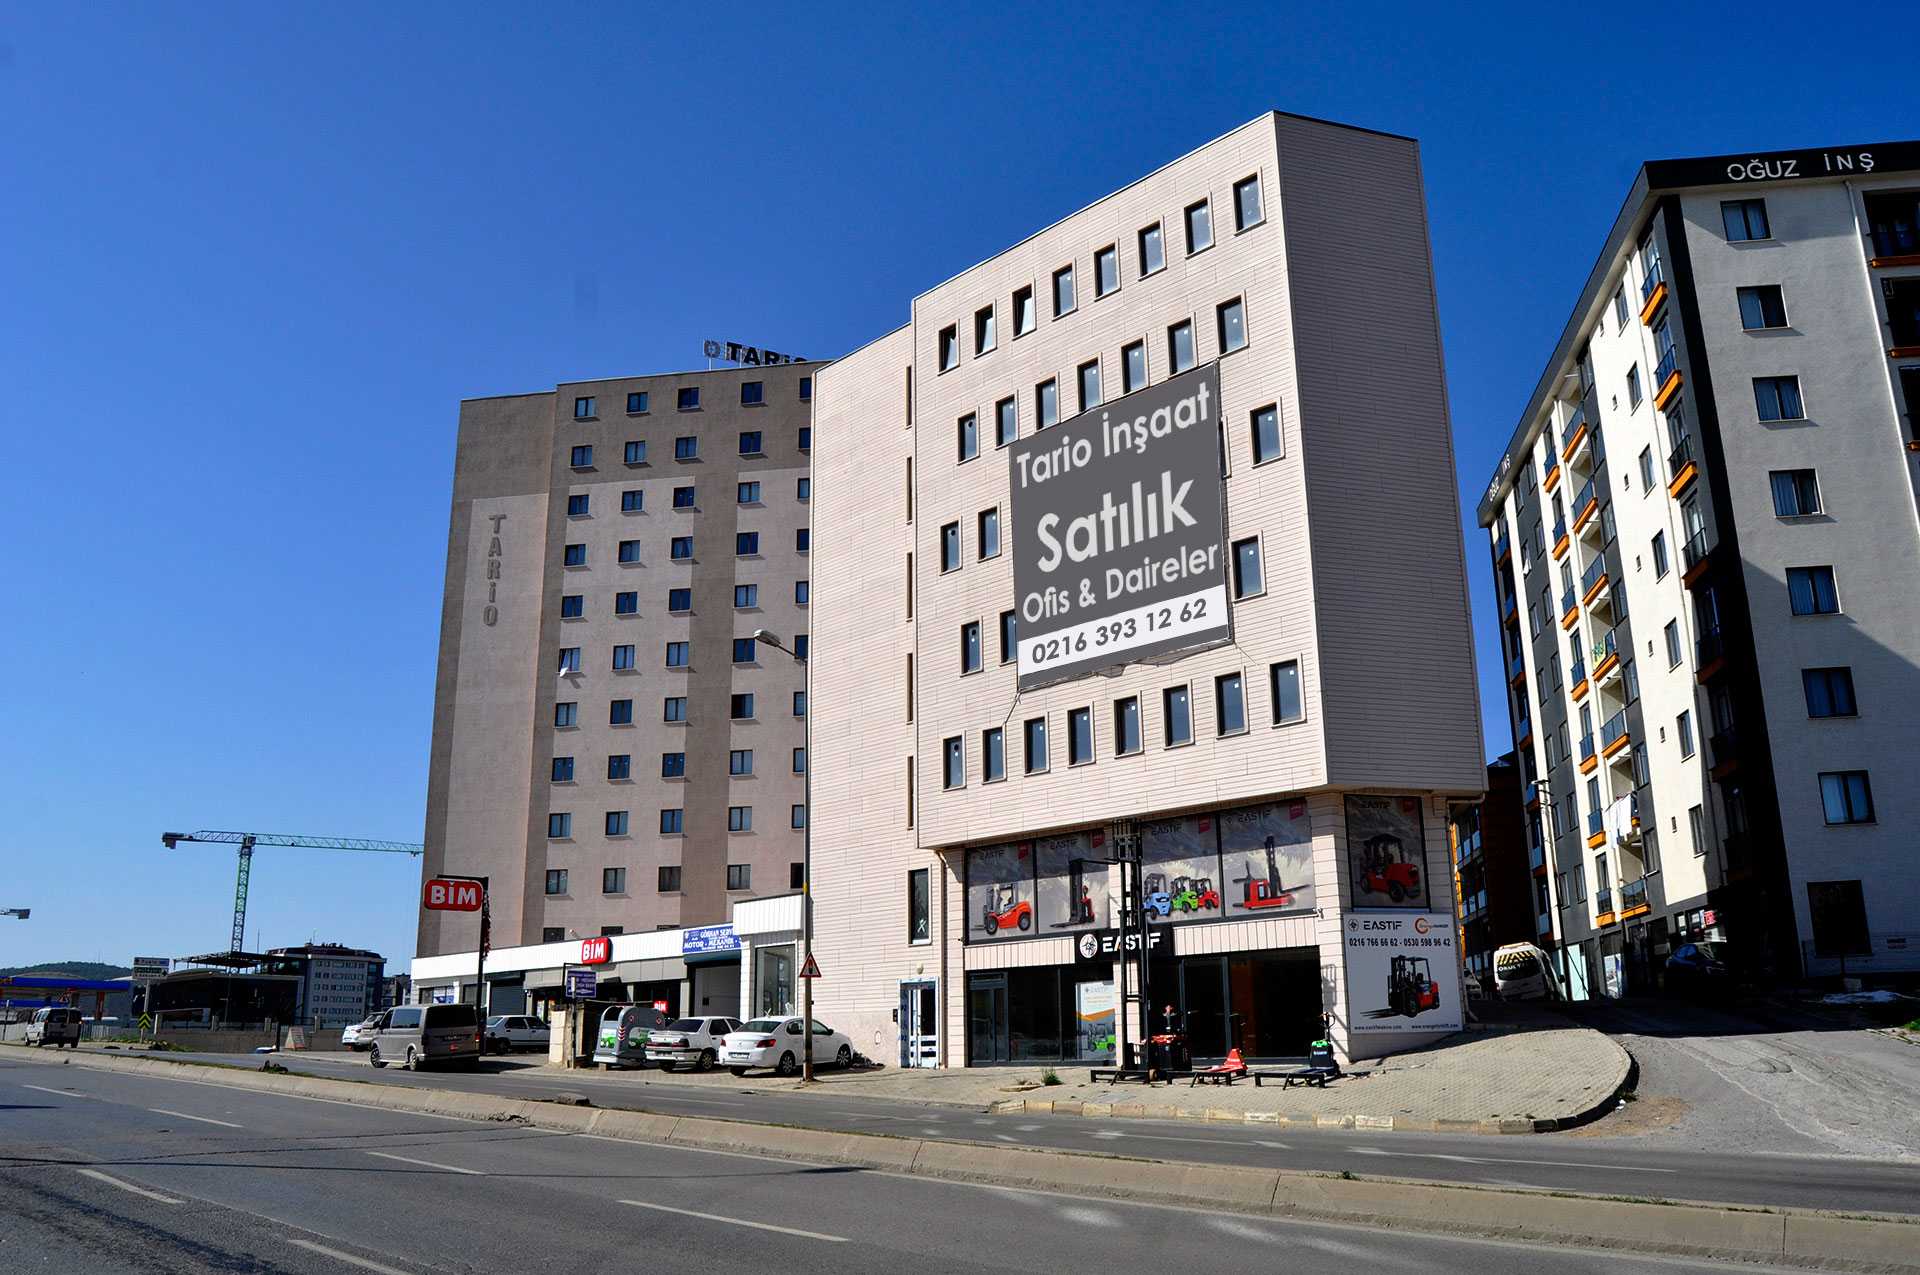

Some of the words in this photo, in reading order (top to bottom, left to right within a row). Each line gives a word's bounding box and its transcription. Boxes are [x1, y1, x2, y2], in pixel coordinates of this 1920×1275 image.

[1727, 159, 1800, 181] OĞUZ
[1824, 153, 1874, 172] İNŞ
[1016, 435, 1092, 489] Tario
[1102, 382, 1210, 457] İnşaat
[1037, 470, 1198, 572] Satılık
[1023, 586, 1071, 623] Ofis
[1079, 578, 1096, 608] &
[1106, 544, 1218, 600] Daireler
[1032, 632, 1087, 664] 0216
[1096, 617, 1137, 646] 393
[1146, 608, 1172, 632] 12
[1180, 598, 1207, 622] 62
[431, 881, 477, 905] BİM
[1363, 920, 1402, 930] EASTIF
[583, 939, 604, 961] BİM
[1349, 938, 1366, 947] 0216
[1404, 938, 1419, 947] 0530
[1443, 938, 1451, 947] 42
